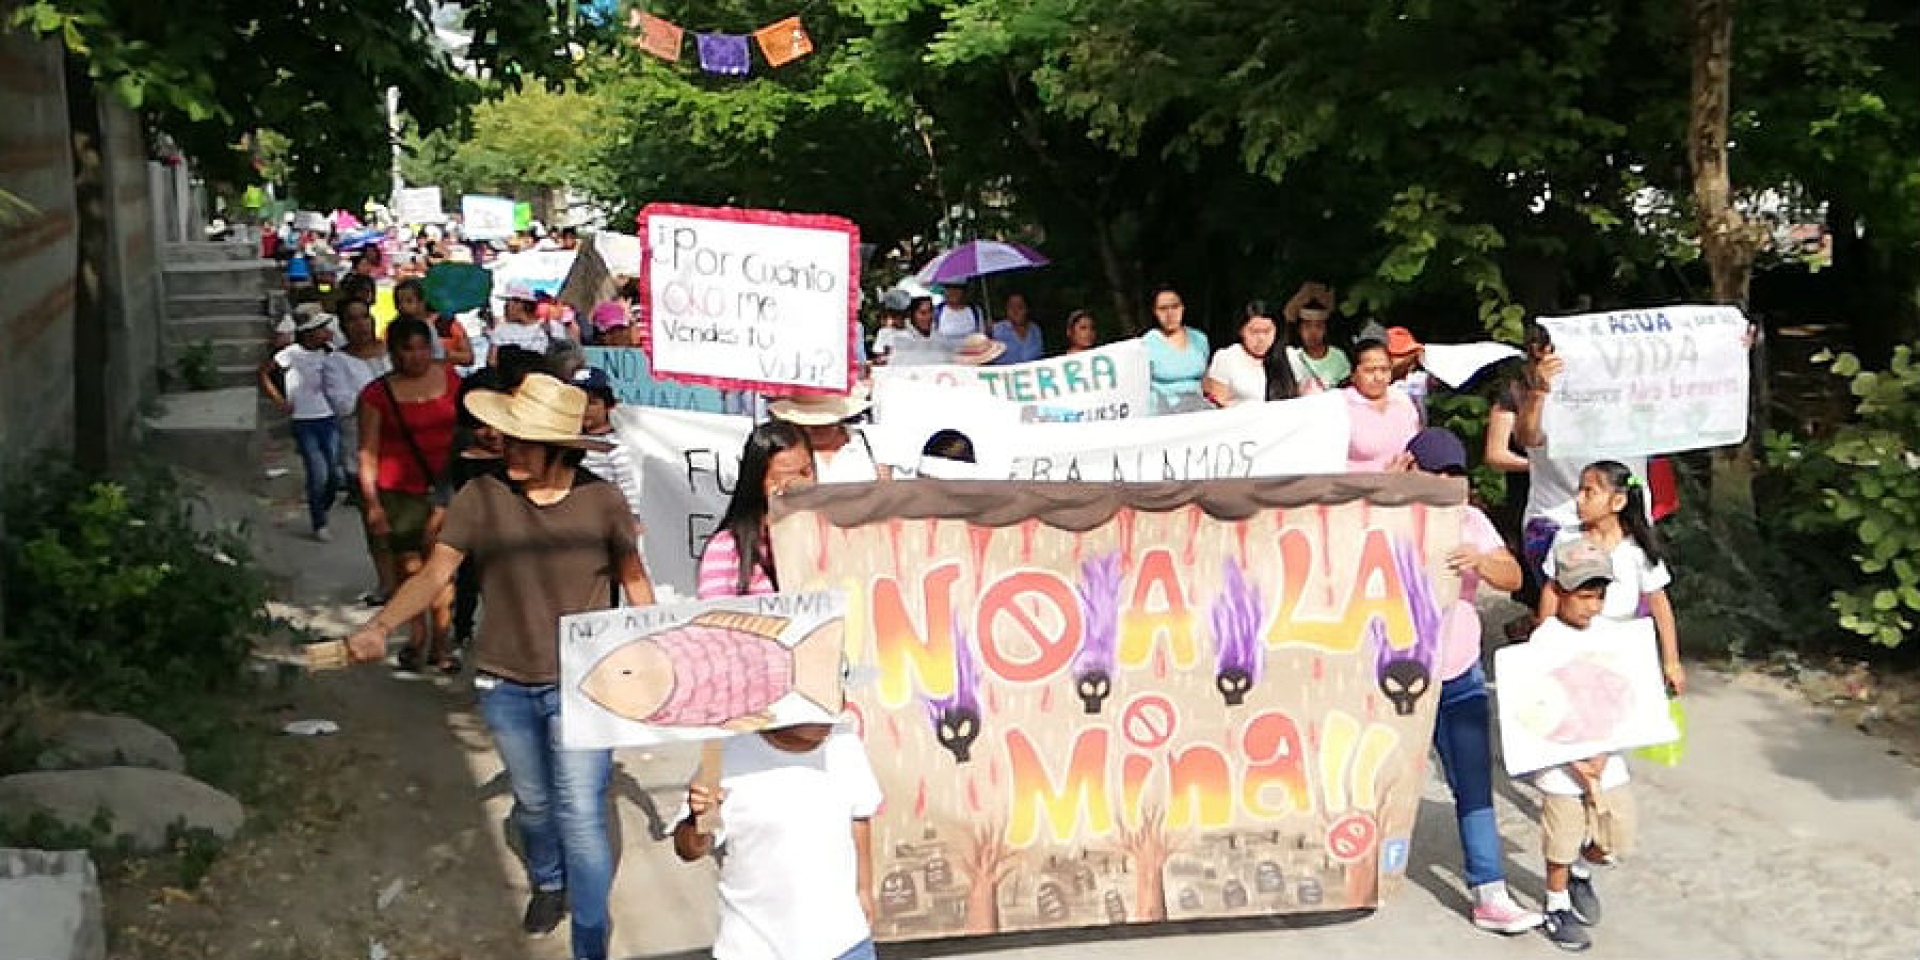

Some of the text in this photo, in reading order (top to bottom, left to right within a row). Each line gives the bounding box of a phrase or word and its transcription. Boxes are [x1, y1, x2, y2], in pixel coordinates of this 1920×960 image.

[1607, 312, 1673, 334] AGUA
[603, 351, 637, 382] NO
[977, 355, 1118, 402] TIERRA
[872, 526, 1419, 707] NO A LA
